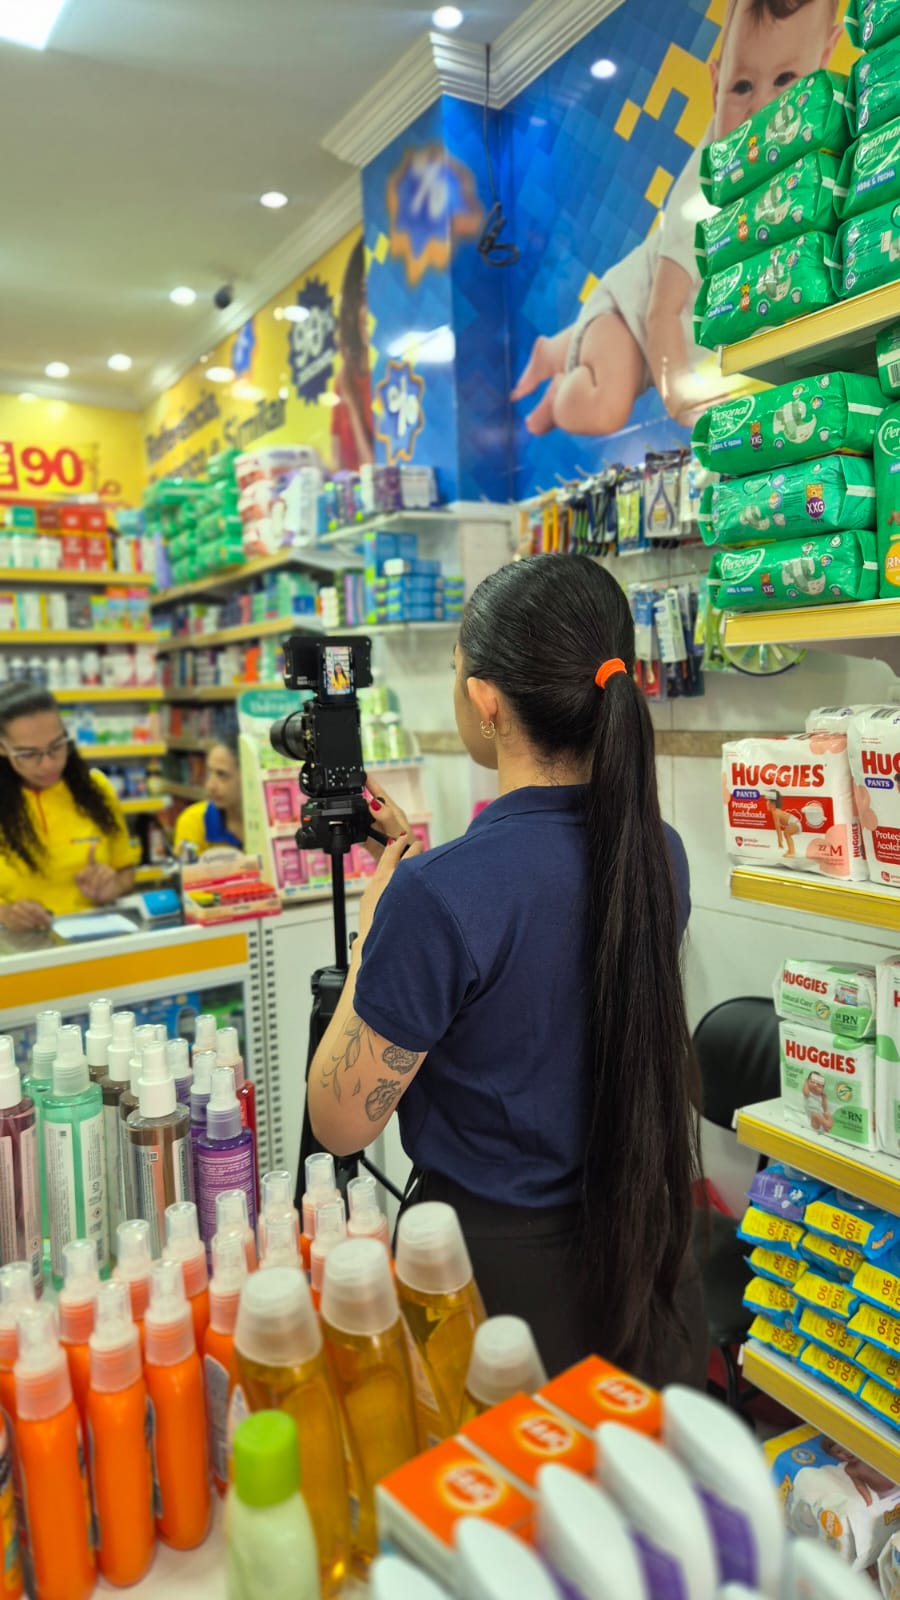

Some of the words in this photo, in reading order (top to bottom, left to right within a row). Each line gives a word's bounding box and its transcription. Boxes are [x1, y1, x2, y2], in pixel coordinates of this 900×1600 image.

[21, 446, 84, 488] 90
[807, 501, 824, 514] XXG
[731, 762, 825, 788] HUGGIES
[867, 779, 891, 788] PANTS
[736, 790, 758, 799] PANTS
[851, 823, 861, 858] HUGGIES
[830, 845, 843, 857] M
[783, 969, 829, 995] HUGGIES
[842, 1014, 859, 1025] RN
[785, 1039, 856, 1075] HUGGIES
[847, 1111, 863, 1123] RN
[831, 1213, 841, 1231] 90
[845, 1217, 859, 1241] 100
[816, 1284, 828, 1301] 90
[881, 1279, 893, 1296] 90
[825, 1320, 837, 1338] 90
[877, 1316, 888, 1336] 90
